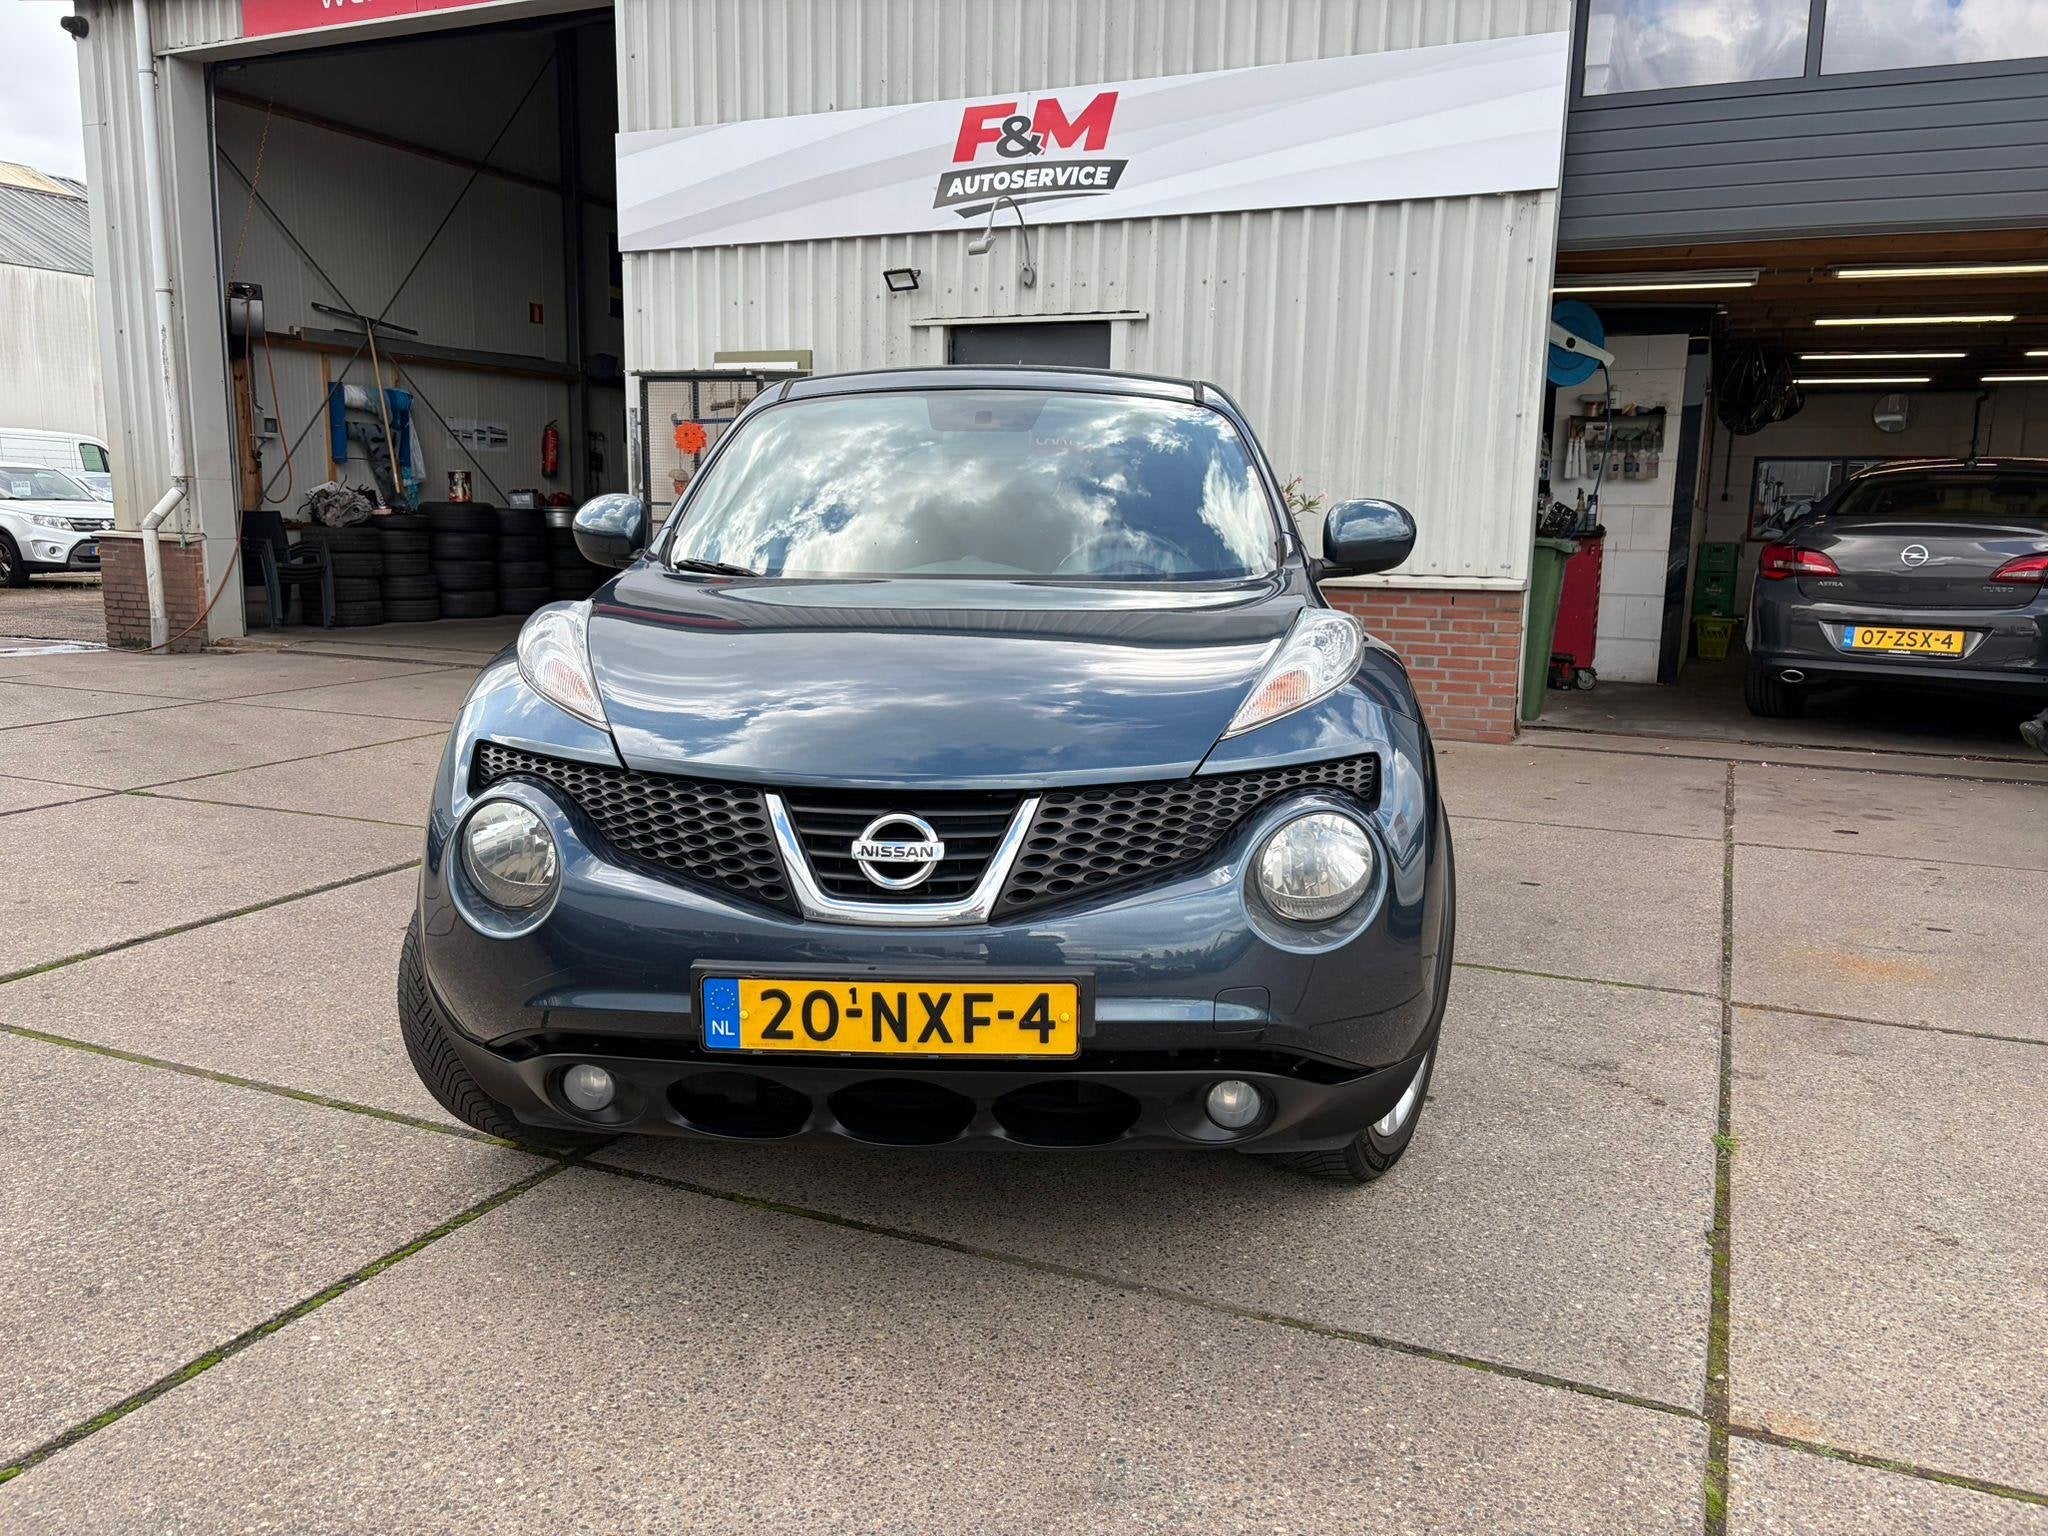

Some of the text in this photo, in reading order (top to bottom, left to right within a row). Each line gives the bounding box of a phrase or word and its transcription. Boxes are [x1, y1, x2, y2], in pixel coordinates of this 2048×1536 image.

[952, 91, 1120, 163] F&M
[946, 166, 1112, 197] AUTOSERVICE
[1861, 629, 1954, 649] 07-ZSX-4
[860, 845, 934, 858] NISSAN
[711, 1019, 735, 1036] NL
